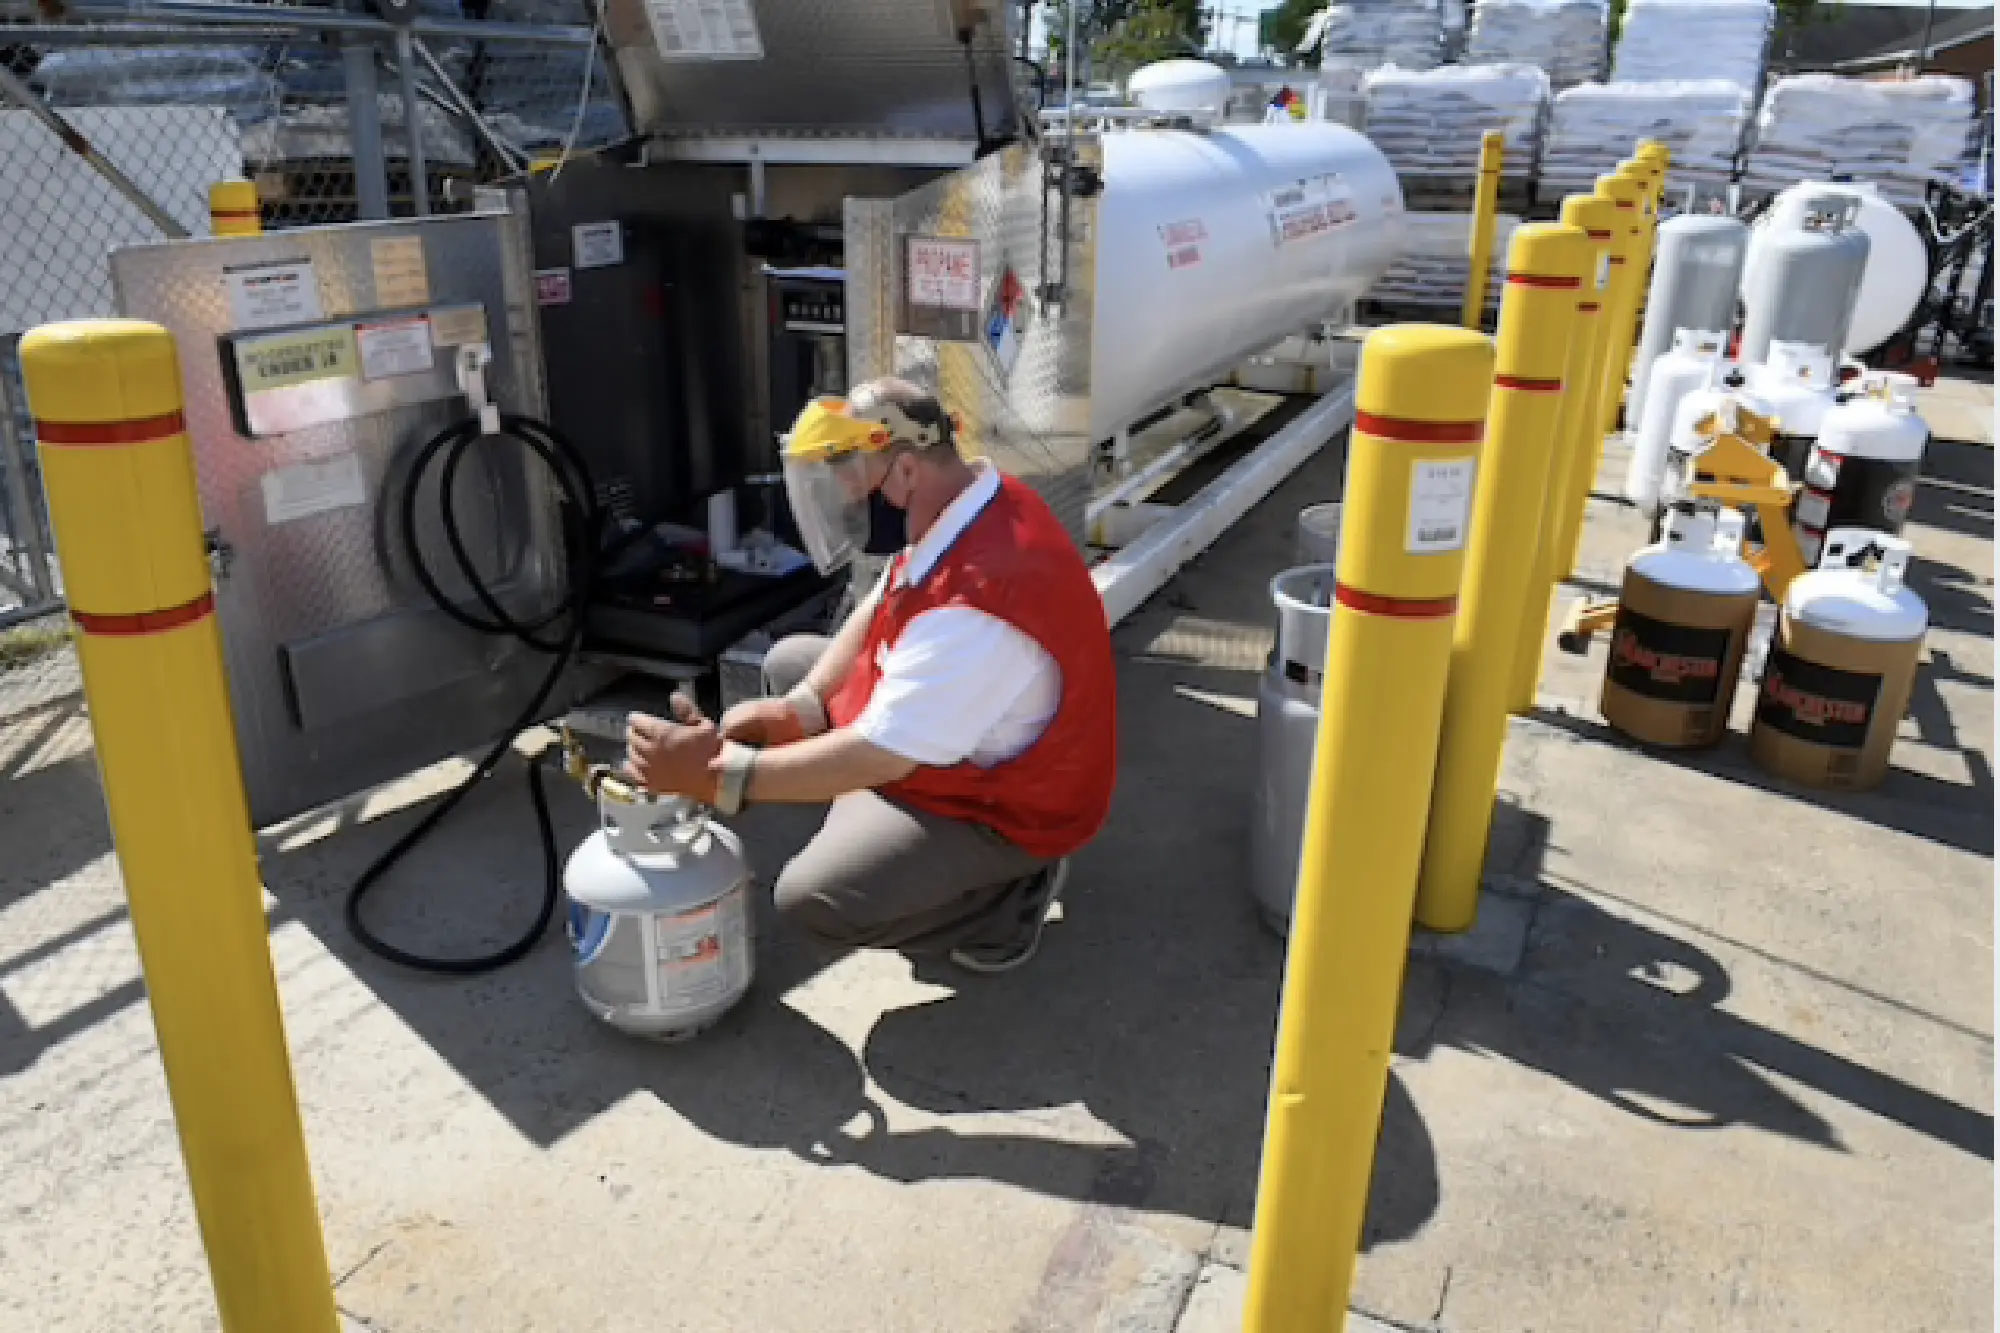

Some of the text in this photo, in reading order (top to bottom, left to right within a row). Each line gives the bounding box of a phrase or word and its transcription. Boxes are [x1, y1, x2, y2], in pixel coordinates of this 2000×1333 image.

[917, 246, 970, 280] PROPANE
[1617, 633, 1718, 677] MANCHESTER
[1765, 672, 1866, 724] MANCHESTER
